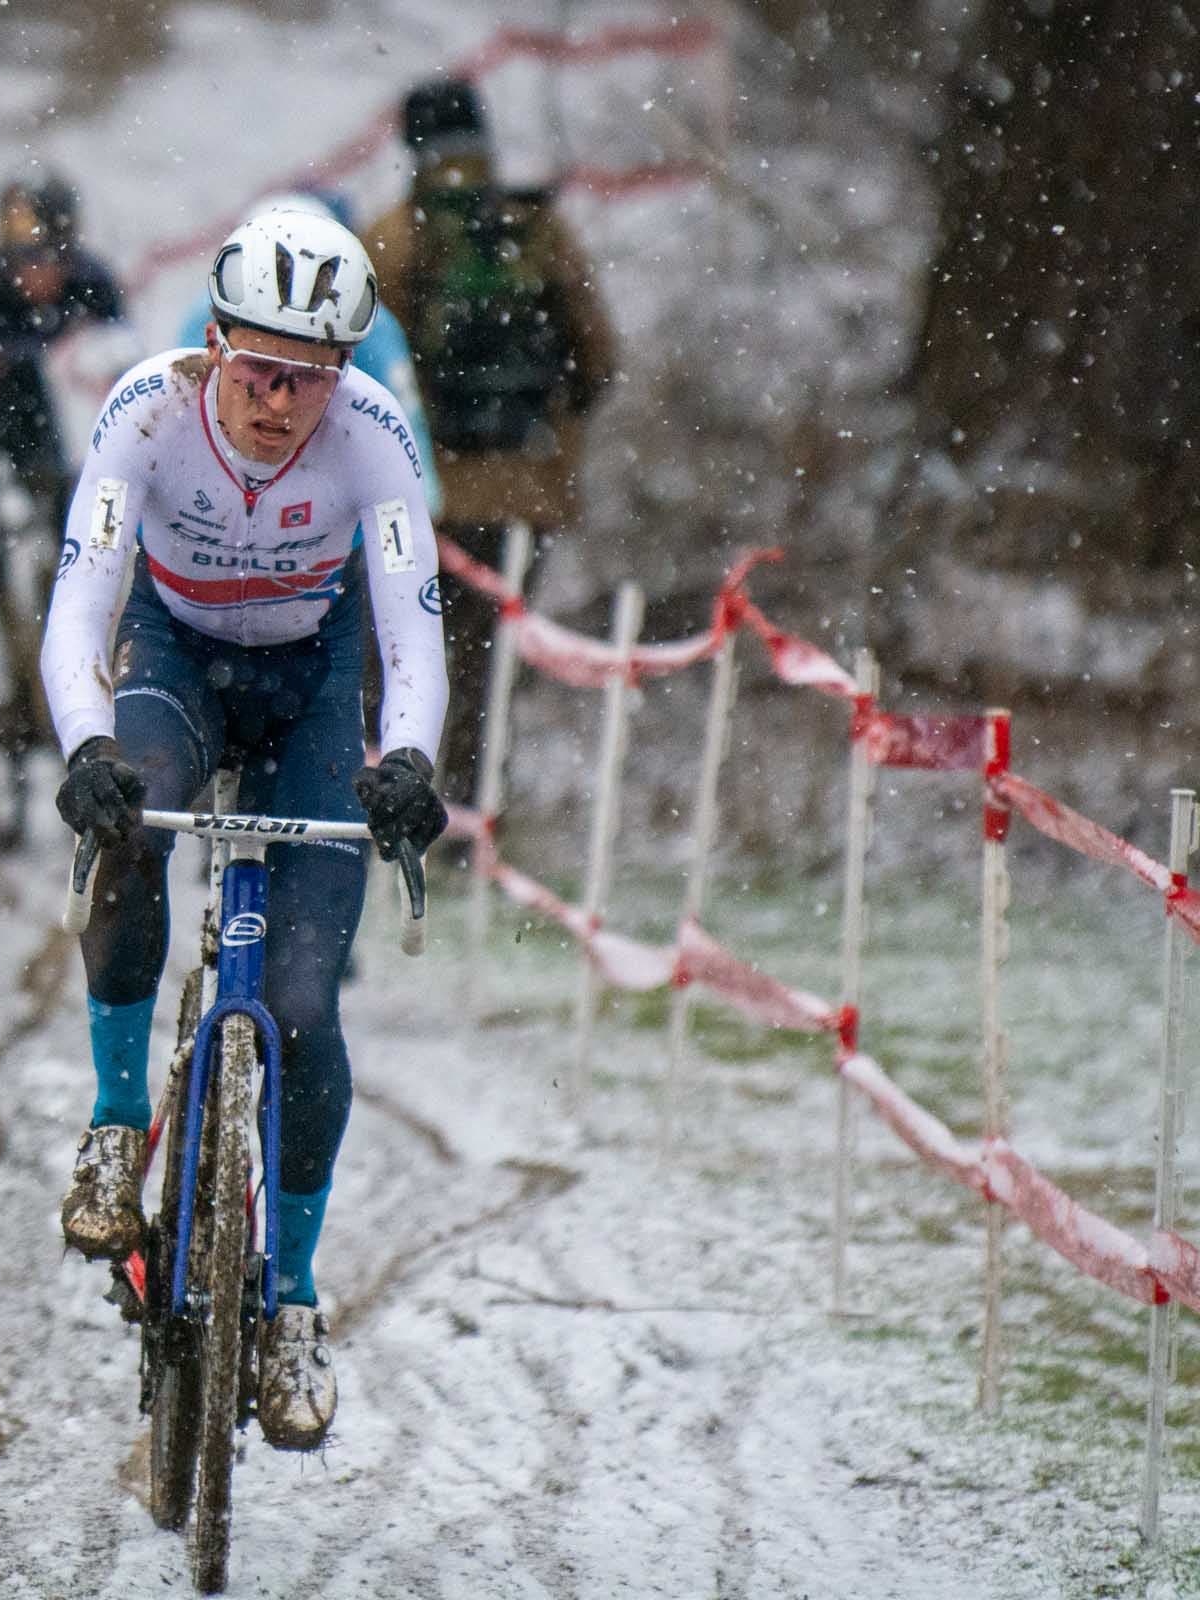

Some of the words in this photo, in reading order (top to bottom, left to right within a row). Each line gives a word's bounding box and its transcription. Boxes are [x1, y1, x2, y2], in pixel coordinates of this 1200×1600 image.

[93, 374, 164, 452] STAGES
[351, 397, 422, 479] JAKROO
[101, 498, 116, 536] 1
[389, 519, 403, 556] 1
[191, 551, 297, 573] BUILD
